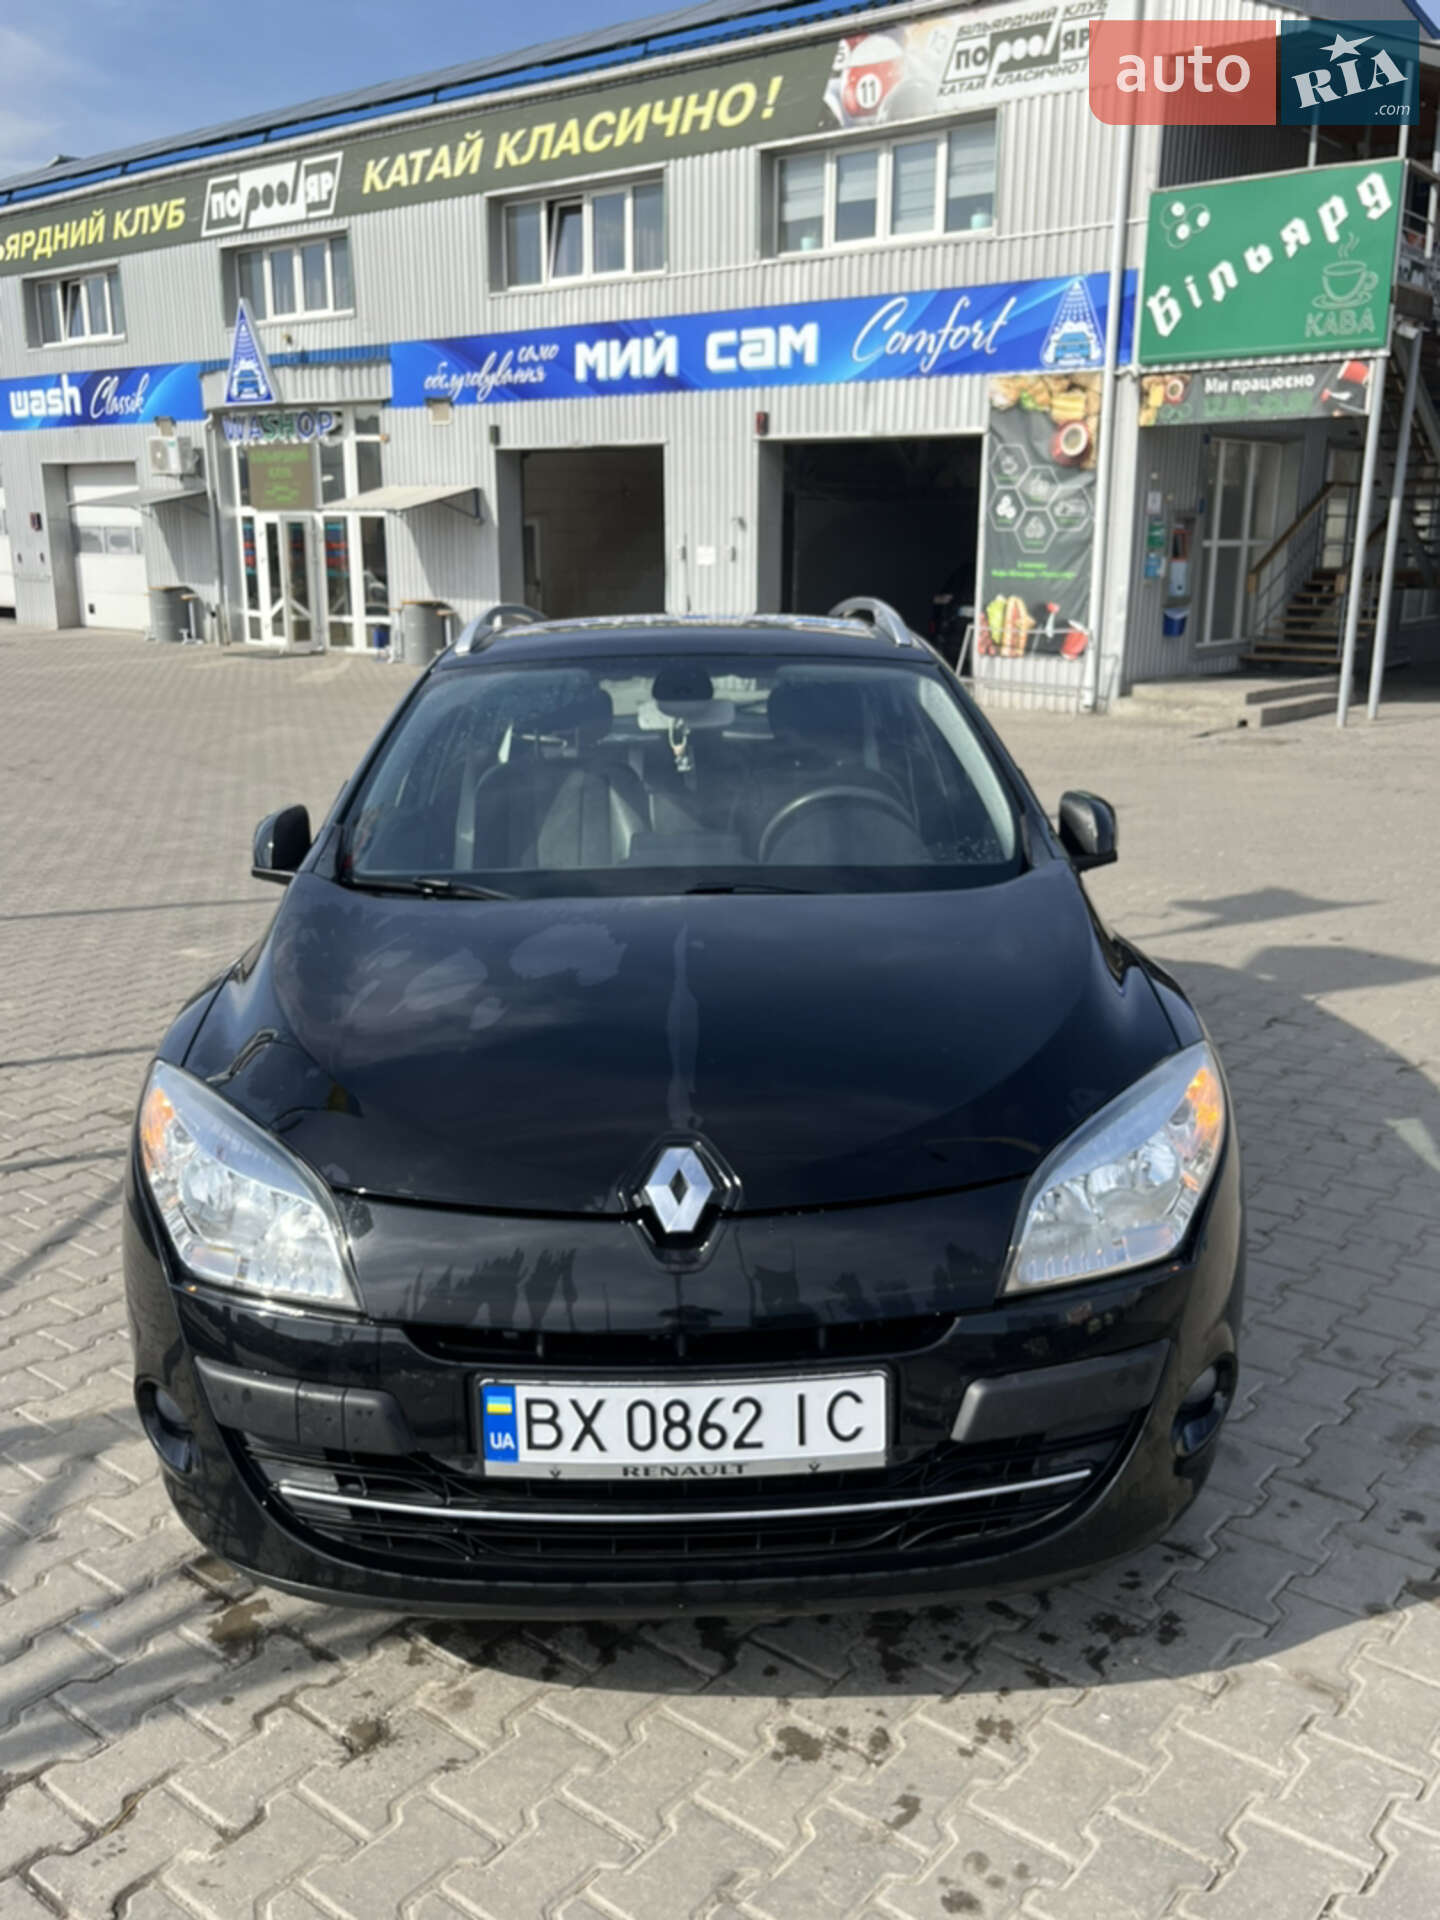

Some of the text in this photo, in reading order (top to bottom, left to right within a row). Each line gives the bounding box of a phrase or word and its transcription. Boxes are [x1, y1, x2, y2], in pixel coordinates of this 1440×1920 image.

[362, 129, 484, 194] КАТАЙ
[113, 197, 186, 241] КЛУБ
[852, 296, 1017, 373] Comfort
[1305, 307, 1376, 338] КАВА
[9, 374, 82, 419] wash
[1204, 378, 1229, 394] Ми
[222, 411, 334, 440] WASHOP
[489, 1432, 515, 1451] UA
[524, 1397, 608, 1452] BX
[626, 1397, 764, 1452] 0862
[622, 1464, 750, 1478] RENAULT
